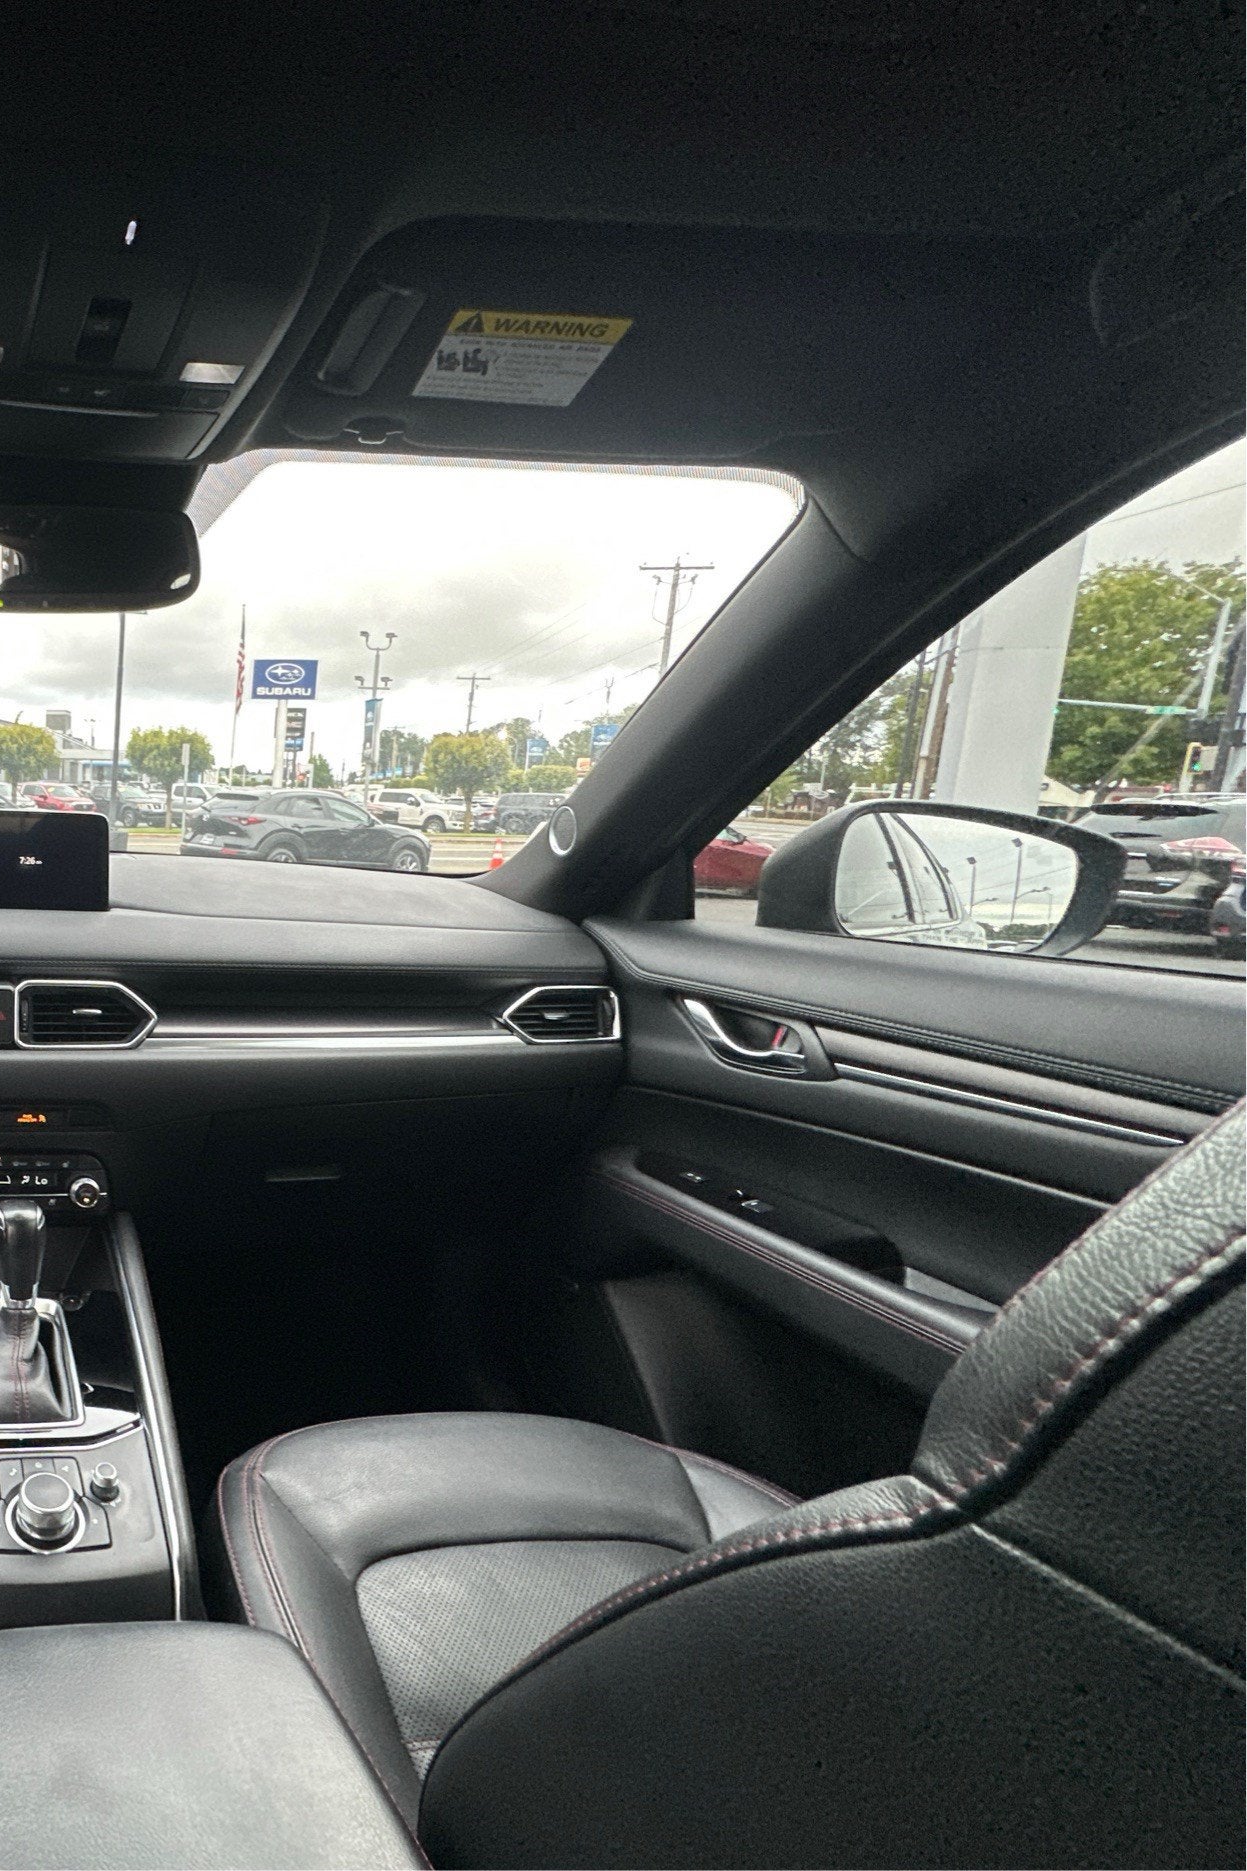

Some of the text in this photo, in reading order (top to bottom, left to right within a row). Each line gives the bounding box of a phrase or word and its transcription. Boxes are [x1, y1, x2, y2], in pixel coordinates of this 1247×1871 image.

[494, 318, 609, 338] WARNING
[256, 686, 312, 696] SUBARU
[19, 856, 36, 865] 7:26
